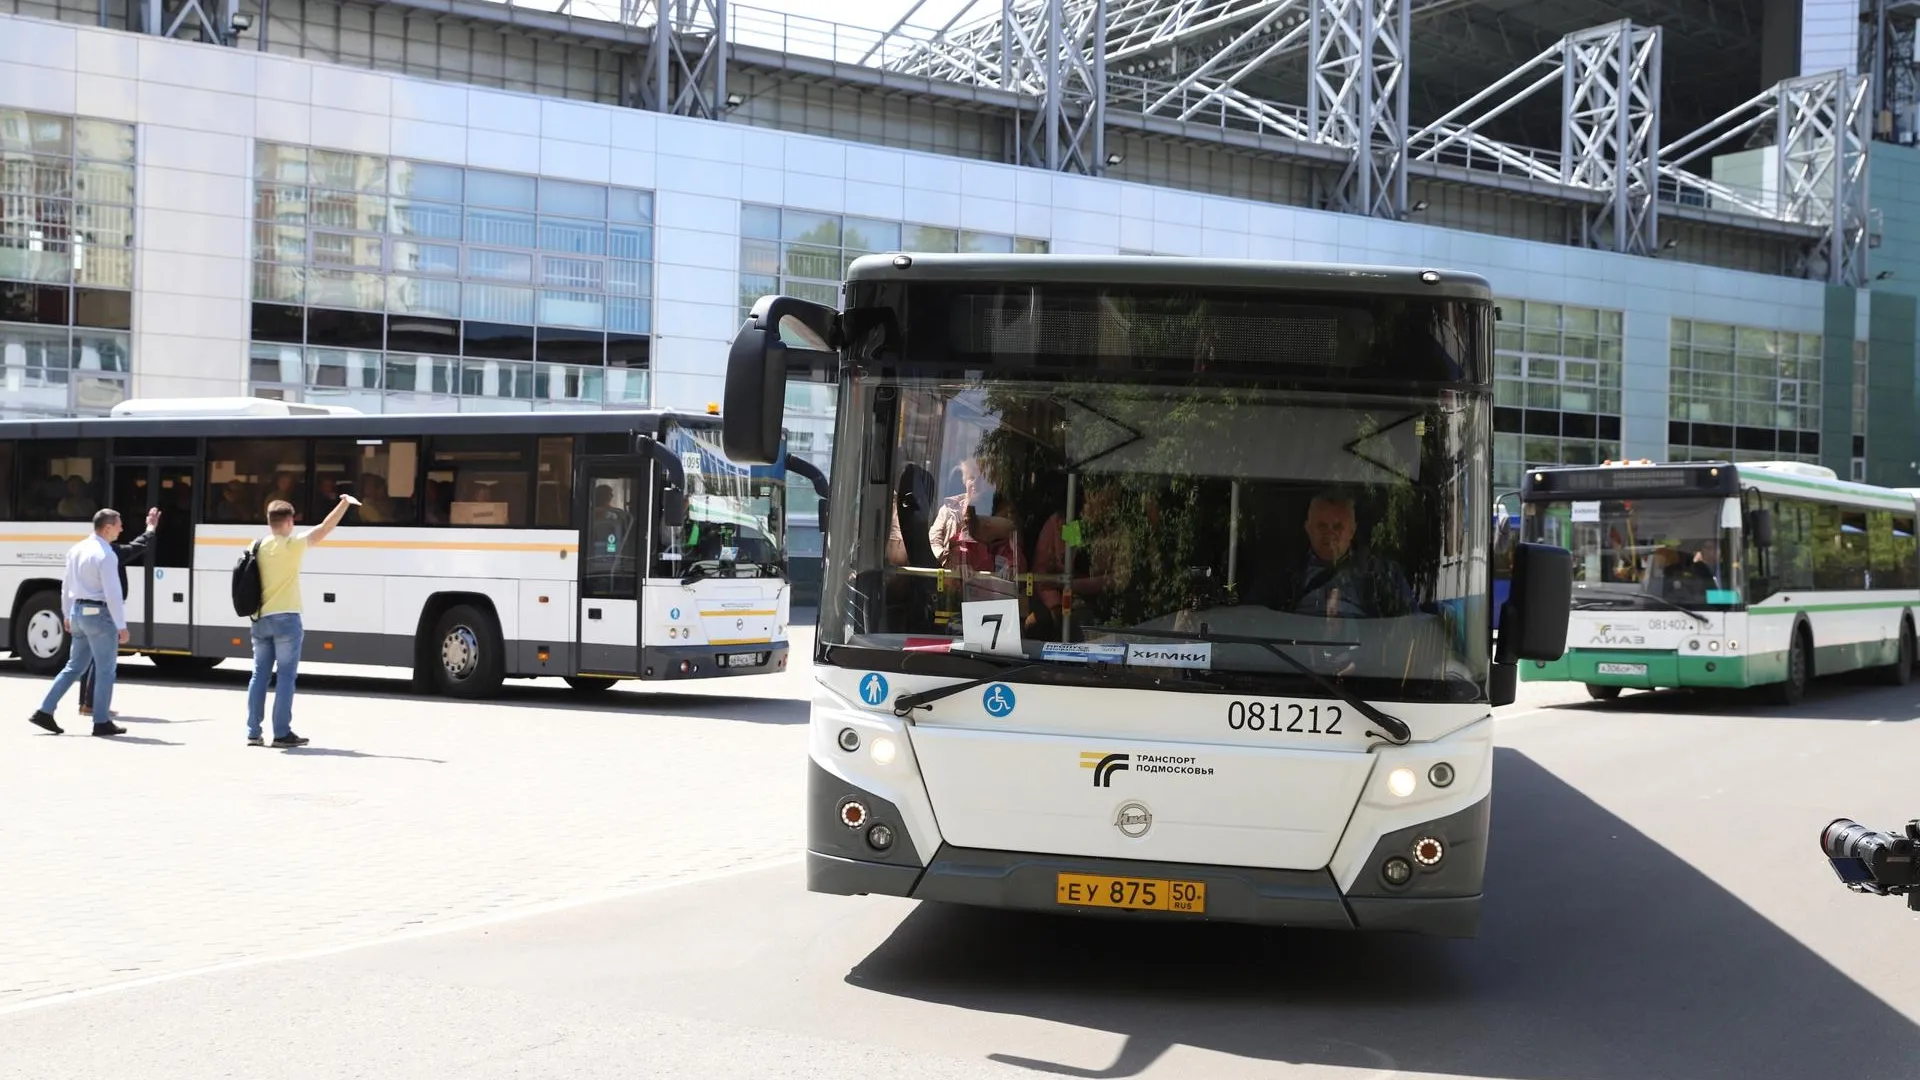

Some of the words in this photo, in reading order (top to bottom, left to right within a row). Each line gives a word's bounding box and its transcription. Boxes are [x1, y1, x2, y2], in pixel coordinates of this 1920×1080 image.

[1648, 619, 1688, 630] 081402
[981, 614, 1003, 650] 7
[1133, 650, 1206, 662] ХИМКИ
[1227, 700, 1343, 735] 081212
[1136, 754, 1196, 764] ТРАНСПОРТ
[1136, 765, 1214, 775] ПОДМОСКОВЬЯ
[1110, 881, 1156, 906] 875
[1172, 884, 1196, 901] 50
[1174, 902, 1192, 910] RUS
